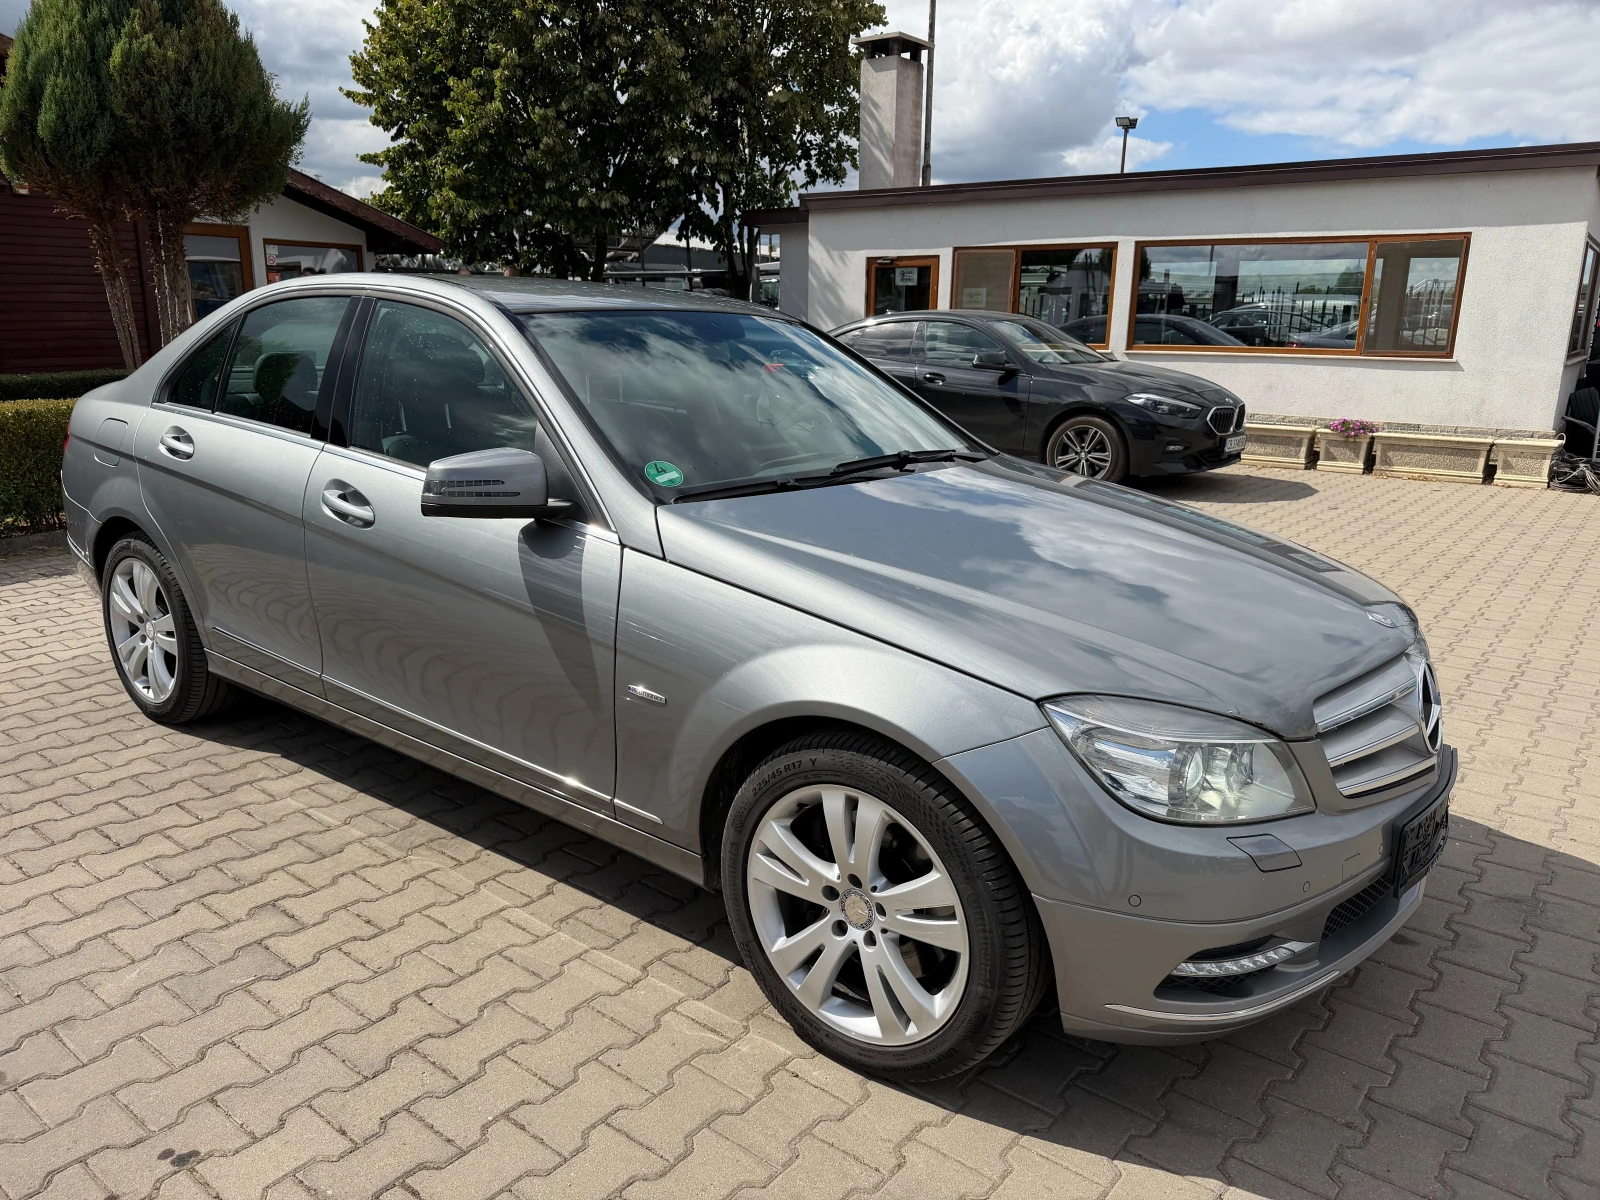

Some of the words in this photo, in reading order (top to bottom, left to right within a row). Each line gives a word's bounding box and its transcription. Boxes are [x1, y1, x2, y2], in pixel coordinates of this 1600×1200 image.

[654, 462, 667, 473] 4
[752, 767, 783, 796] 225/45
[784, 760, 802, 773] R17
[809, 757, 818, 767] Y
[881, 1047, 959, 1073] UltraContact
